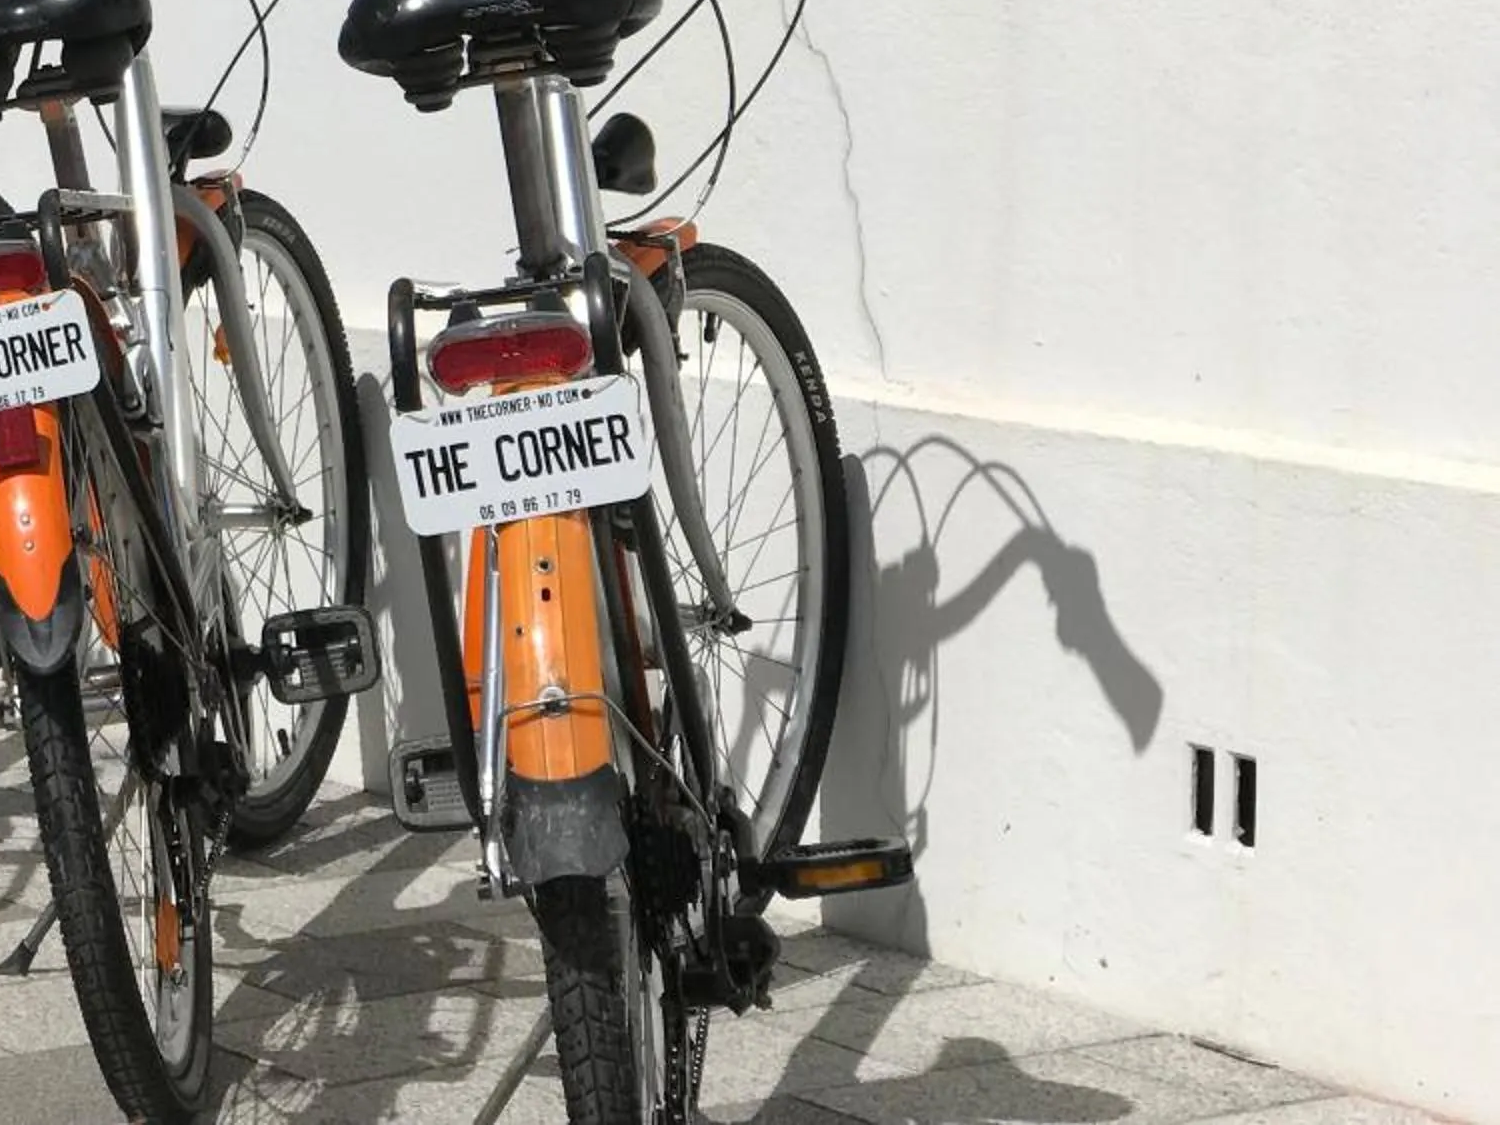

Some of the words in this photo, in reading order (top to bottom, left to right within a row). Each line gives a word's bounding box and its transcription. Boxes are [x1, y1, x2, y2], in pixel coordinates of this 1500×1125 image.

[794, 350, 828, 424] KENDA
[404, 441, 477, 498] THE
[495, 414, 636, 483] CORNER
[545, 491, 559, 508] 17
[565, 487, 582, 506] 79
